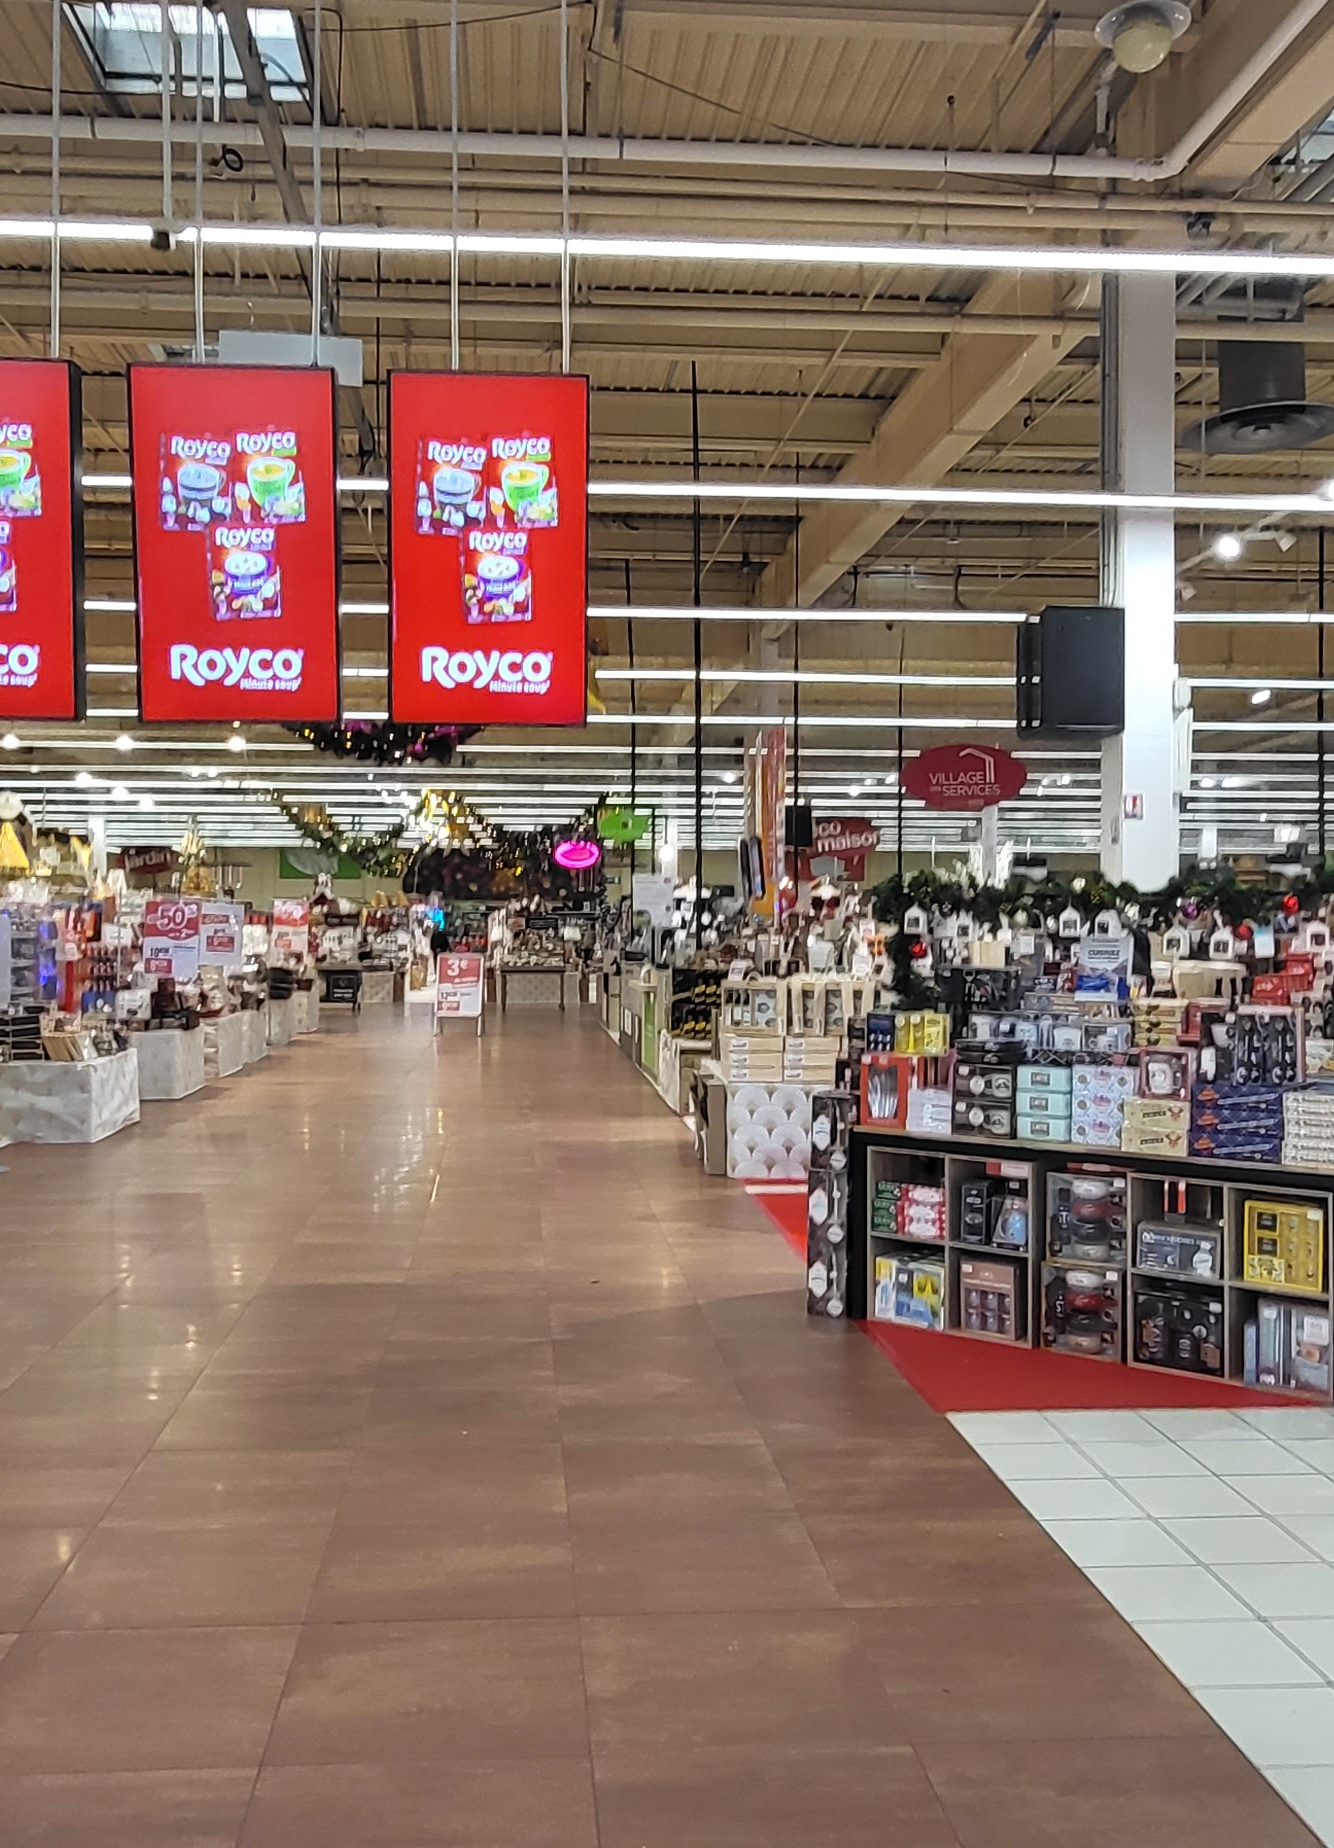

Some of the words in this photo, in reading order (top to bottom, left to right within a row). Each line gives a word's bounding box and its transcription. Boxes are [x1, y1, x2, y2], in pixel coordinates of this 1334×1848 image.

[171, 436, 231, 459] Royco
[236, 432, 296, 454] Royco
[428, 441, 487, 464] Royco
[492, 437, 551, 459] Royco
[215, 527, 275, 548] Royco
[469, 531, 528, 553] Royco
[170, 644, 304, 687] Royco
[421, 645, 554, 689] Royco
[929, 771, 985, 785] VILLAGE
[943, 784, 1000, 797] SERVICES
